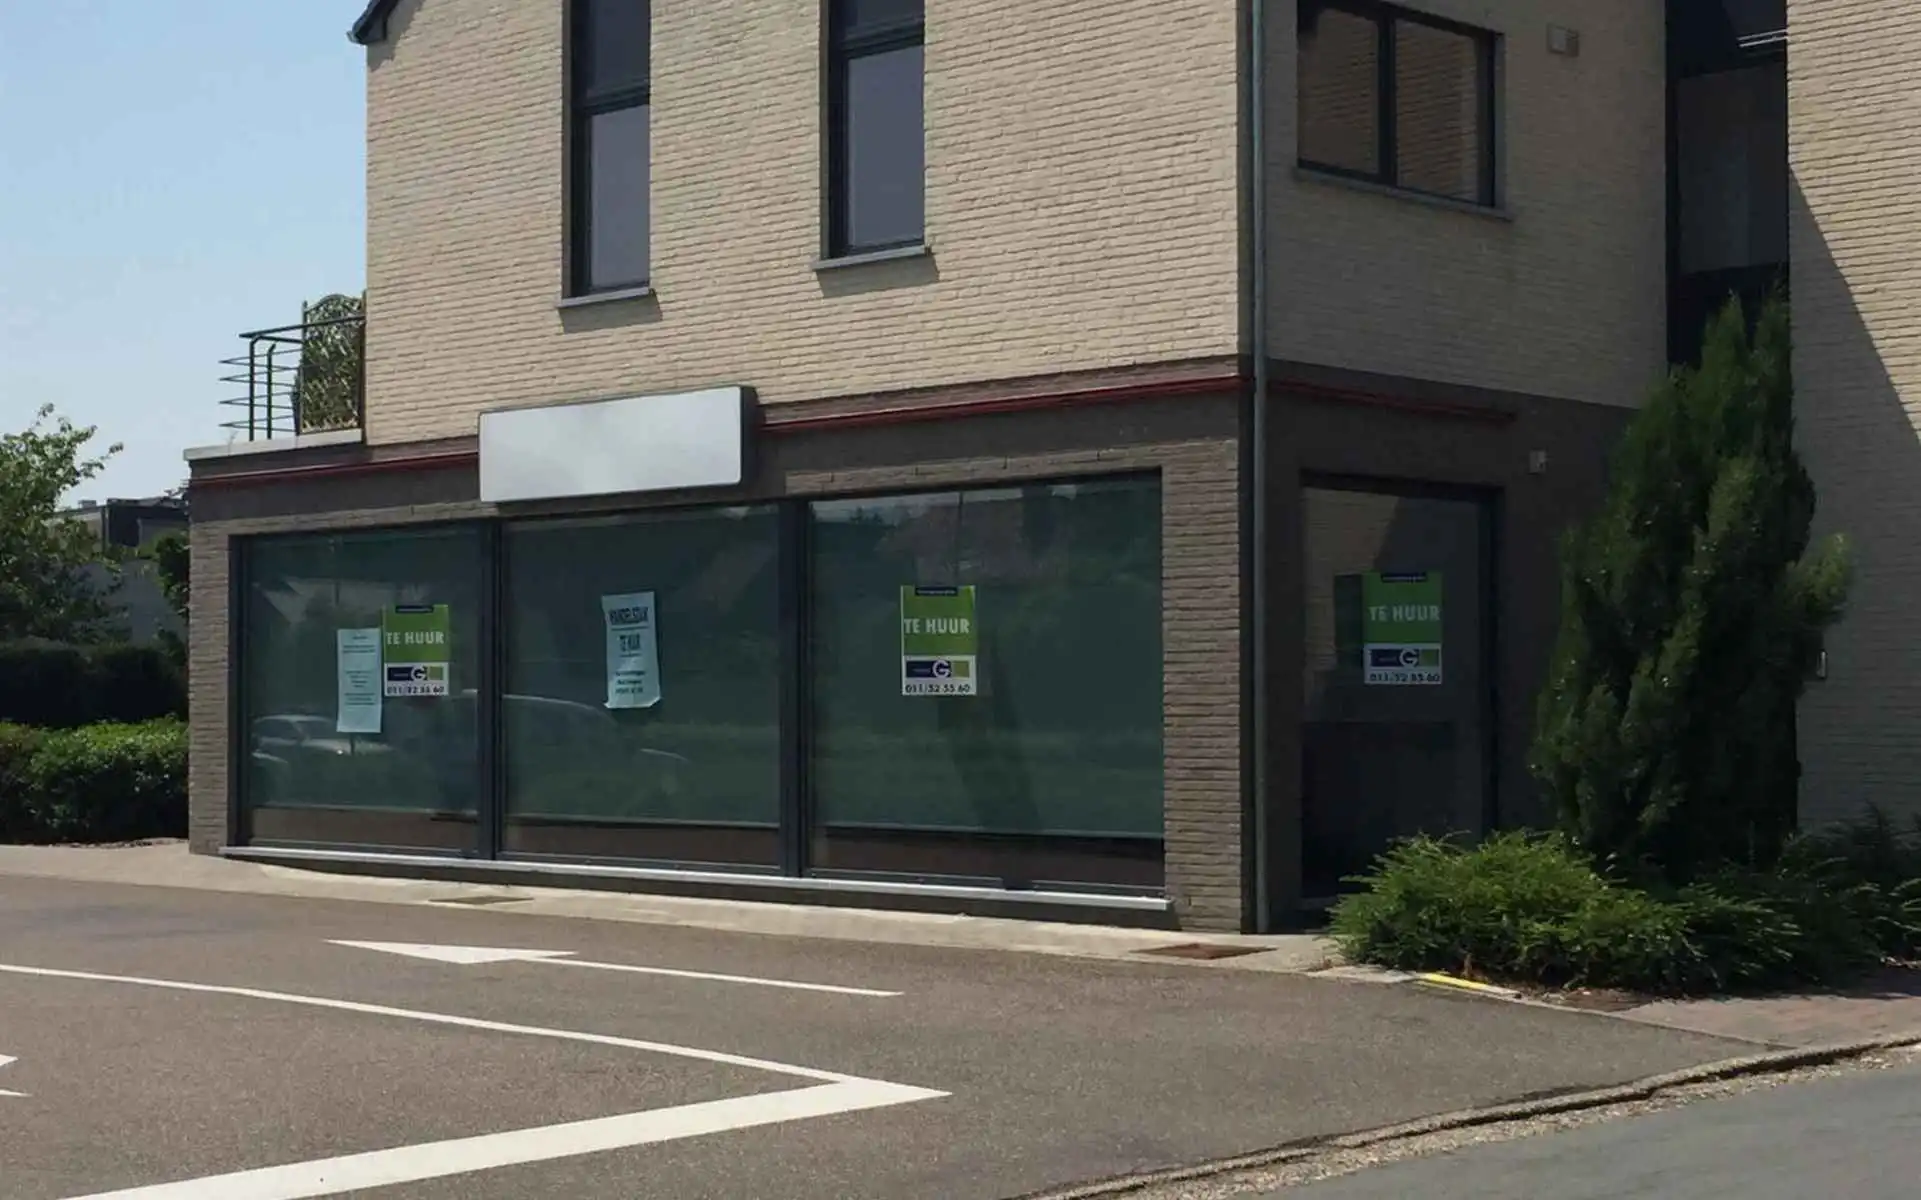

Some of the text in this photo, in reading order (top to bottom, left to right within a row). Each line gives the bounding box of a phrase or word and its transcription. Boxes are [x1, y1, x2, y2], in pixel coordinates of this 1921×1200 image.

[1368, 605, 1441, 622] TE HUUR
[904, 618, 970, 634] TE HUUR
[386, 631, 444, 645] TE HUUR
[932, 659, 951, 679] G
